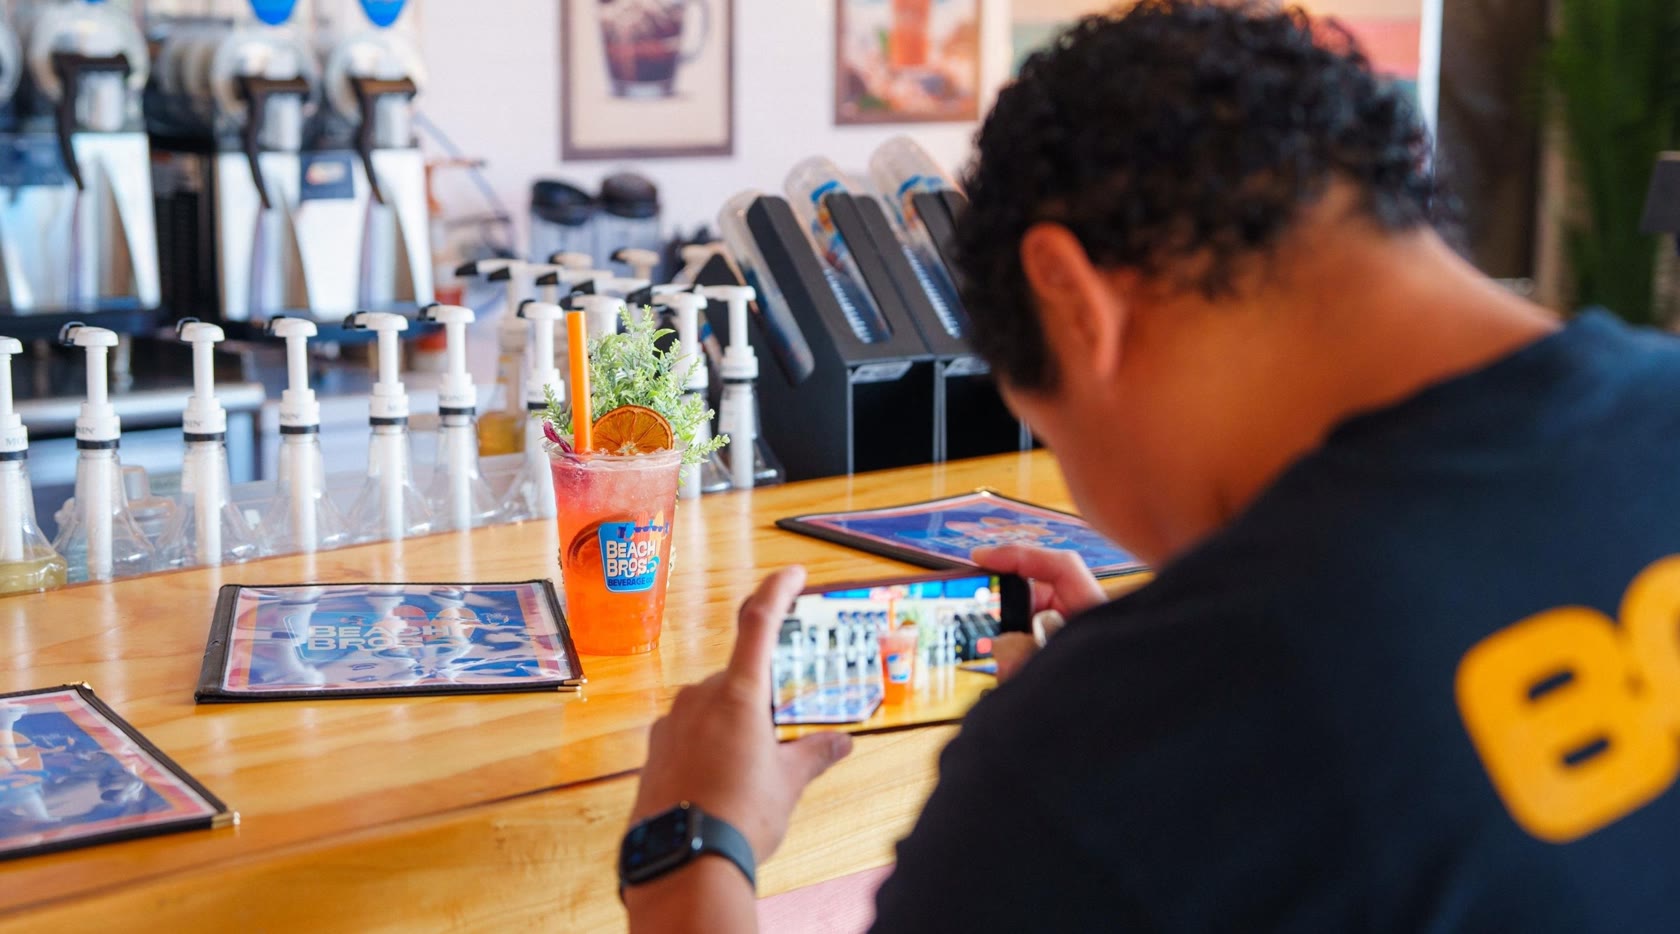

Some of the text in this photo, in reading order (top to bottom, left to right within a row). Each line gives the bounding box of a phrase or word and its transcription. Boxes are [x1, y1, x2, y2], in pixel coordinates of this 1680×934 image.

[606, 540, 656, 559] BEACH
[608, 577, 646, 587] BEVERAGE
[308, 625, 451, 637] BEACH
